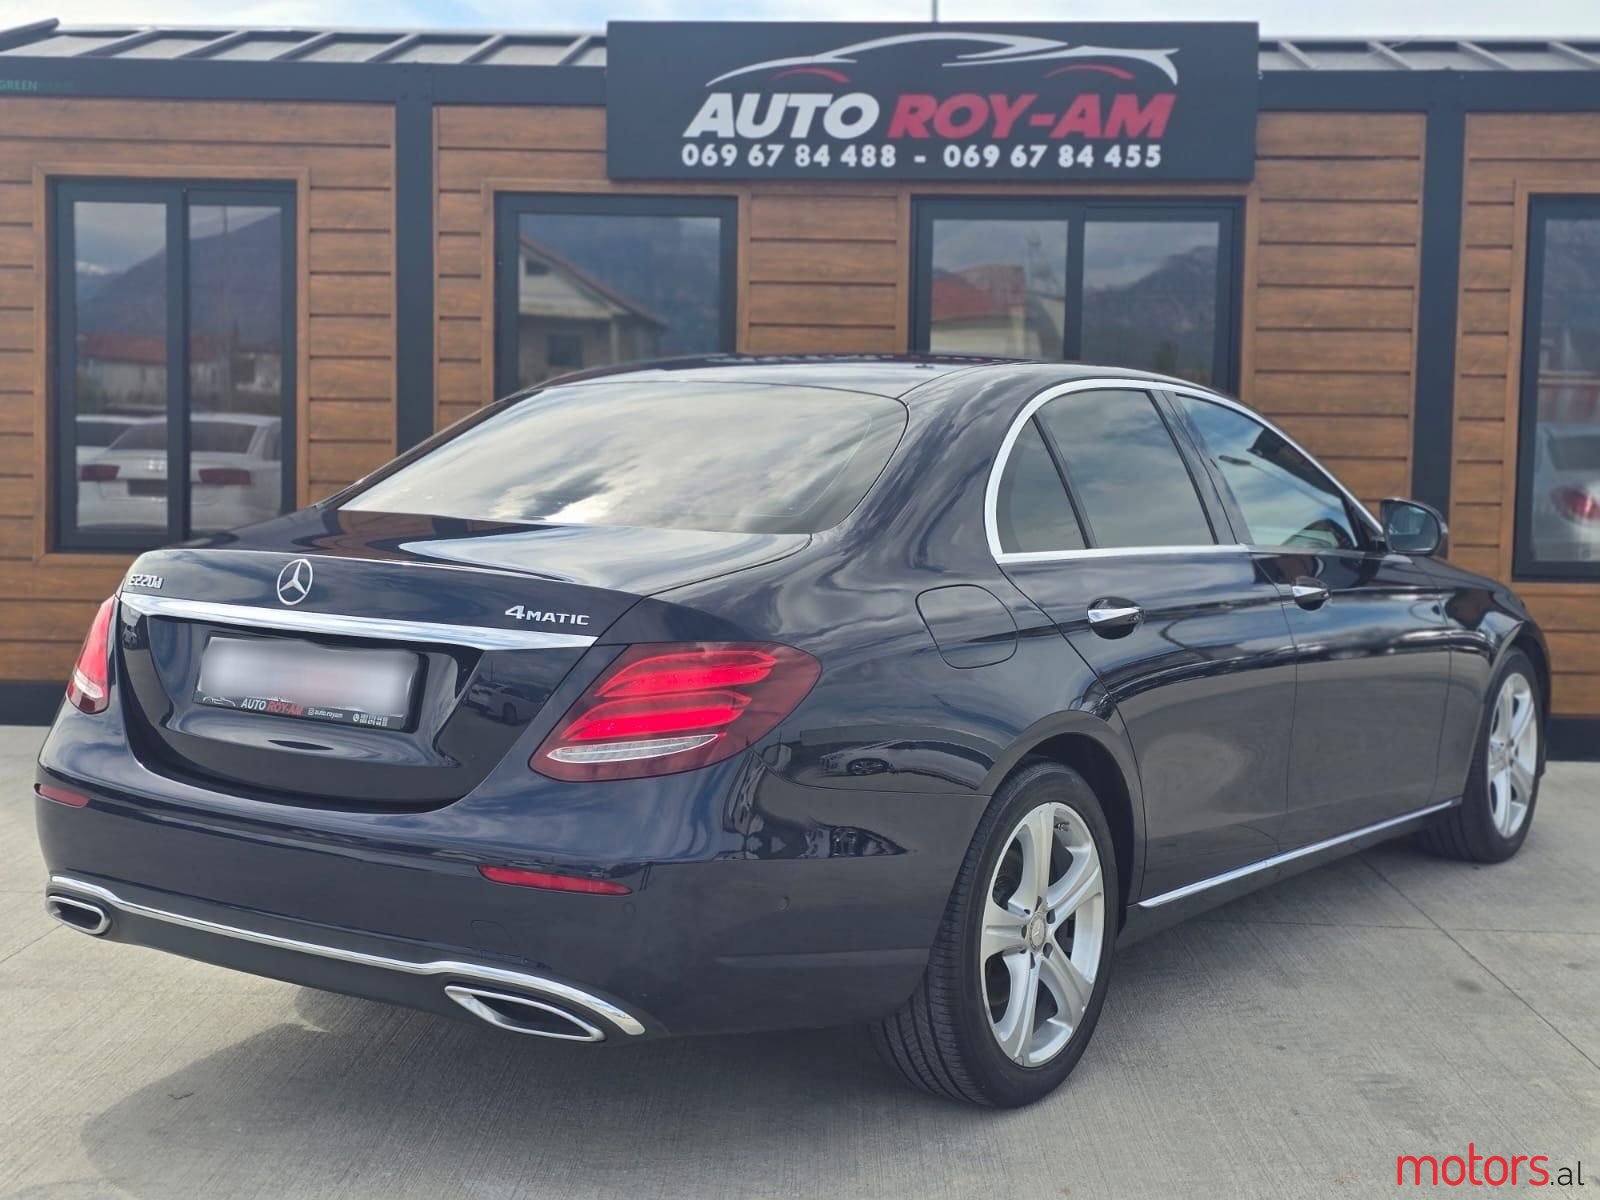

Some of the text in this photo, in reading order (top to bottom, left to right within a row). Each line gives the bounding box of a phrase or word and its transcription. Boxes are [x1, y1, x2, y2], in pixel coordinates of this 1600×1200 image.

[682, 92, 1177, 140] AUTO ROY-AM
[682, 143, 738, 167] 069
[748, 144, 784, 167] 67
[795, 144, 830, 167] 84
[840, 144, 897, 167] 488
[943, 144, 1000, 168] 069
[1010, 144, 1048, 168] 67
[1058, 144, 1094, 168] 84
[1104, 144, 1161, 168] 455
[127, 574, 164, 589] E220d
[505, 605, 590, 626] 4MATIC
[240, 698, 304, 716] AUTO ROY-AM
